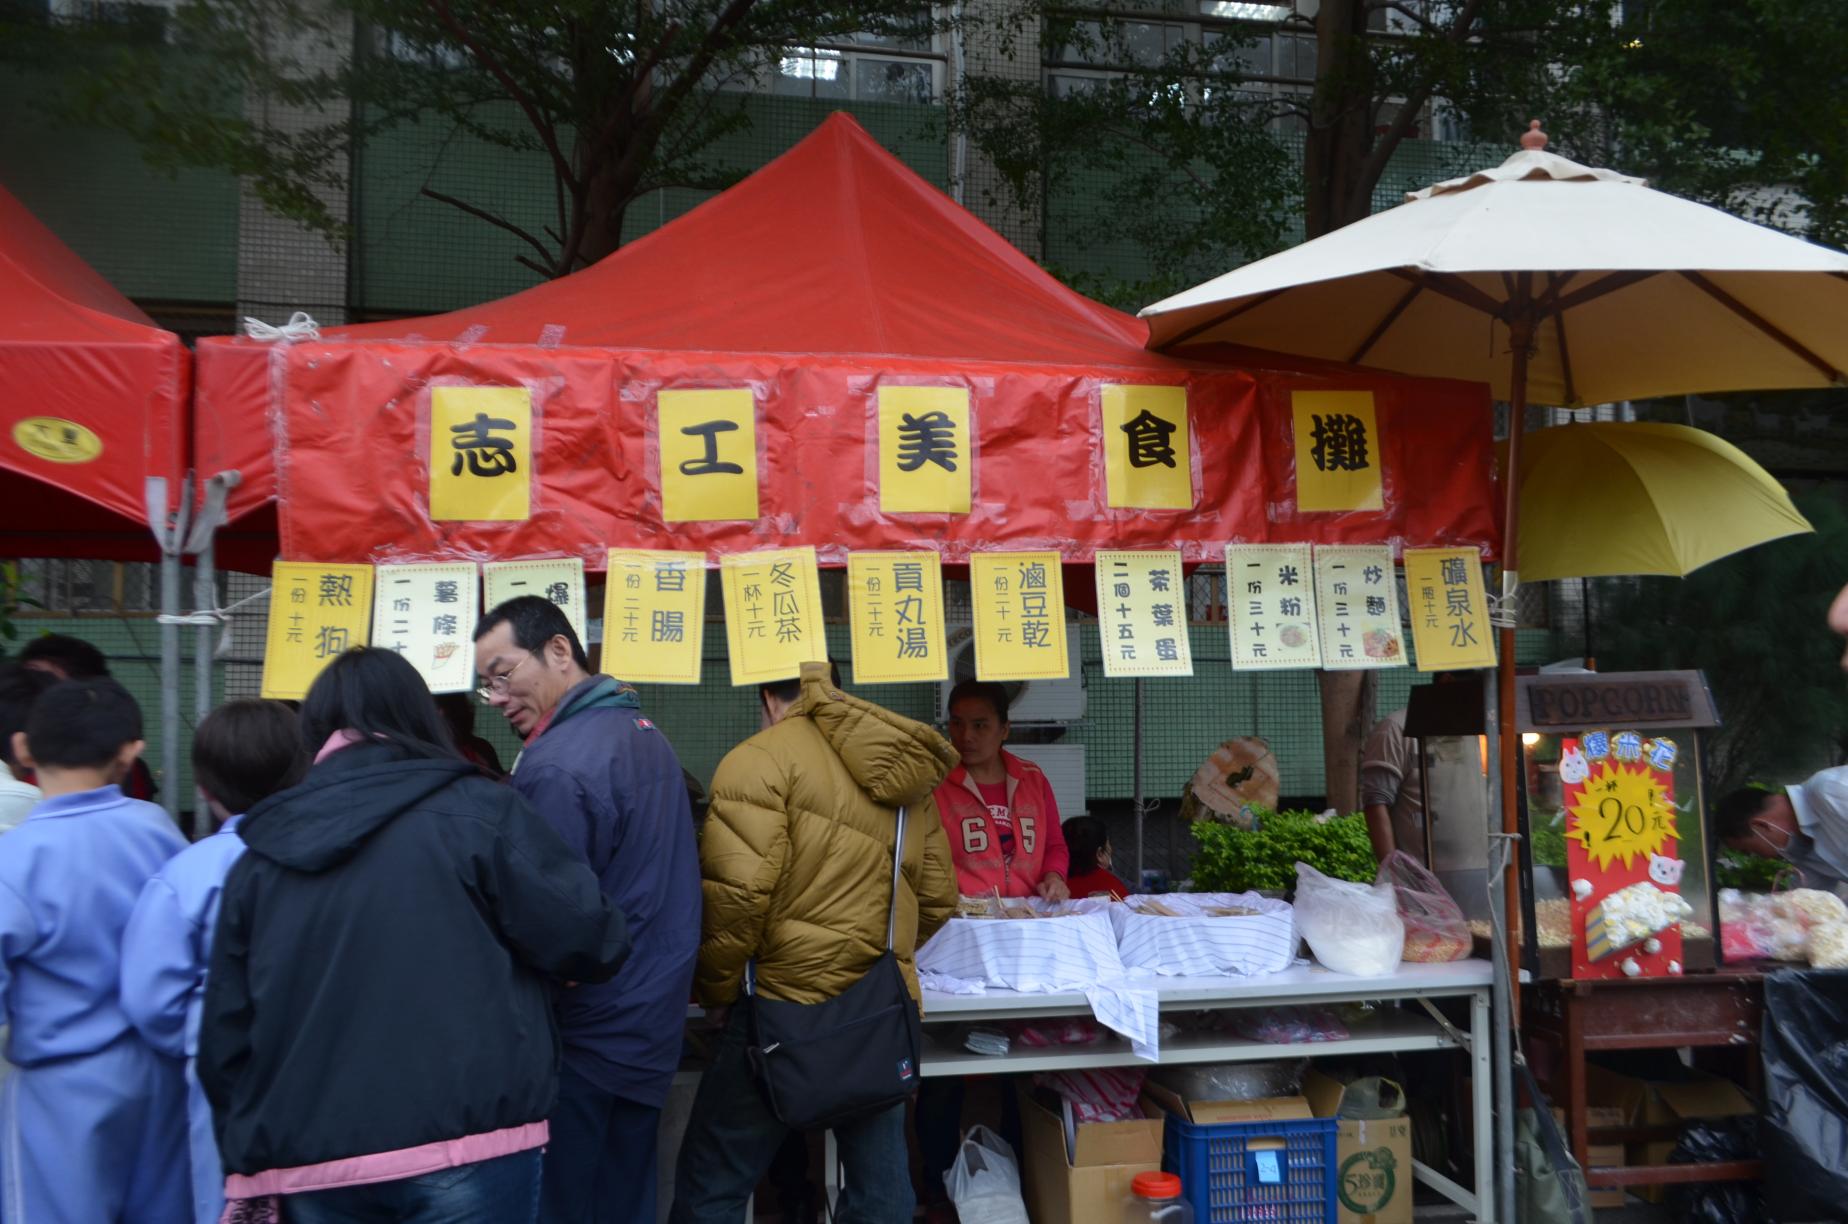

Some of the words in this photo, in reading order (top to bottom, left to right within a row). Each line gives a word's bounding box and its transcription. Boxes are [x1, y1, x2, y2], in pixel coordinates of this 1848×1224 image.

[450, 409, 1370, 477] 志工美食攤
[286, 577, 308, 643] 一份十元
[314, 573, 353, 659] 熱狗
[621, 564, 641, 642] 一份二十元
[650, 560, 687, 642] 香腸
[741, 571, 768, 638] 一杯十元
[769, 561, 802, 644] 冬瓜茶
[865, 567, 885, 637] 一份二十元
[892, 562, 928, 659] 貢丸湯
[993, 567, 1012, 642] 一份二十元
[1018, 561, 1052, 648] 滷豆乾
[1148, 568, 1179, 661] 茶葉蛋
[1246, 562, 1268, 658] 一份三十元
[1278, 565, 1302, 617] 米粉
[1331, 564, 1354, 658] 一份三十元
[1362, 564, 1387, 617] 炒麵
[1420, 576, 1439, 628] 一瓶十元
[1439, 556, 1479, 648] 礦泉水
[1536, 684, 1691, 719] POPCORN
[1583, 730, 1677, 772] 爆米花
[961, 815, 989, 854] 6
[1019, 816, 1036, 854] 5
[1598, 796, 1646, 842] 20
